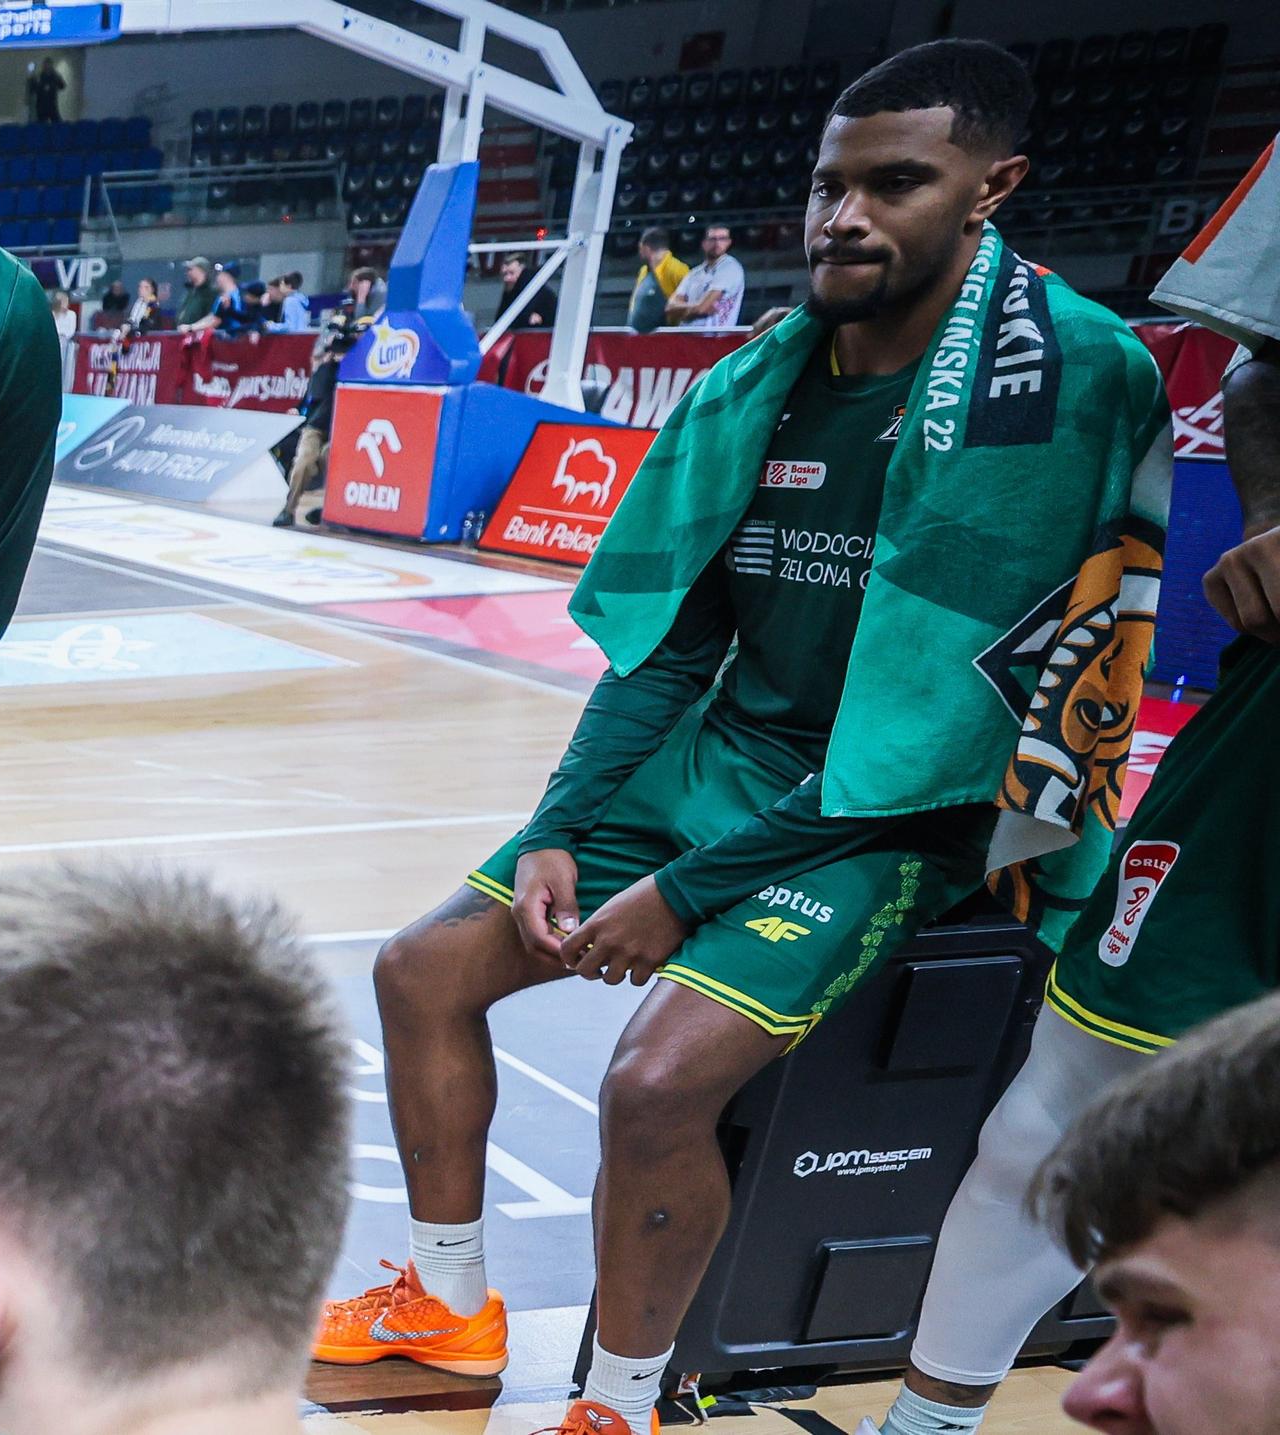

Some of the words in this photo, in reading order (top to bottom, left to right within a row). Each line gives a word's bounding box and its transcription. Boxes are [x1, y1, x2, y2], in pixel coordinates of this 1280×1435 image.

[54, 257, 108, 290] VIP
[378, 342, 408, 366] LOTTO
[923, 419, 956, 452] 22
[789, 475, 808, 486] Liga
[790, 464, 820, 476] Basket
[344, 482, 401, 512] ORLEN
[501, 516, 550, 542] Bank
[744, 916, 812, 943] 4F
[1108, 925, 1130, 946] Basket
[1107, 938, 1121, 954] Liga
[837, 1161, 907, 1176] www.jpmsystem.pl
